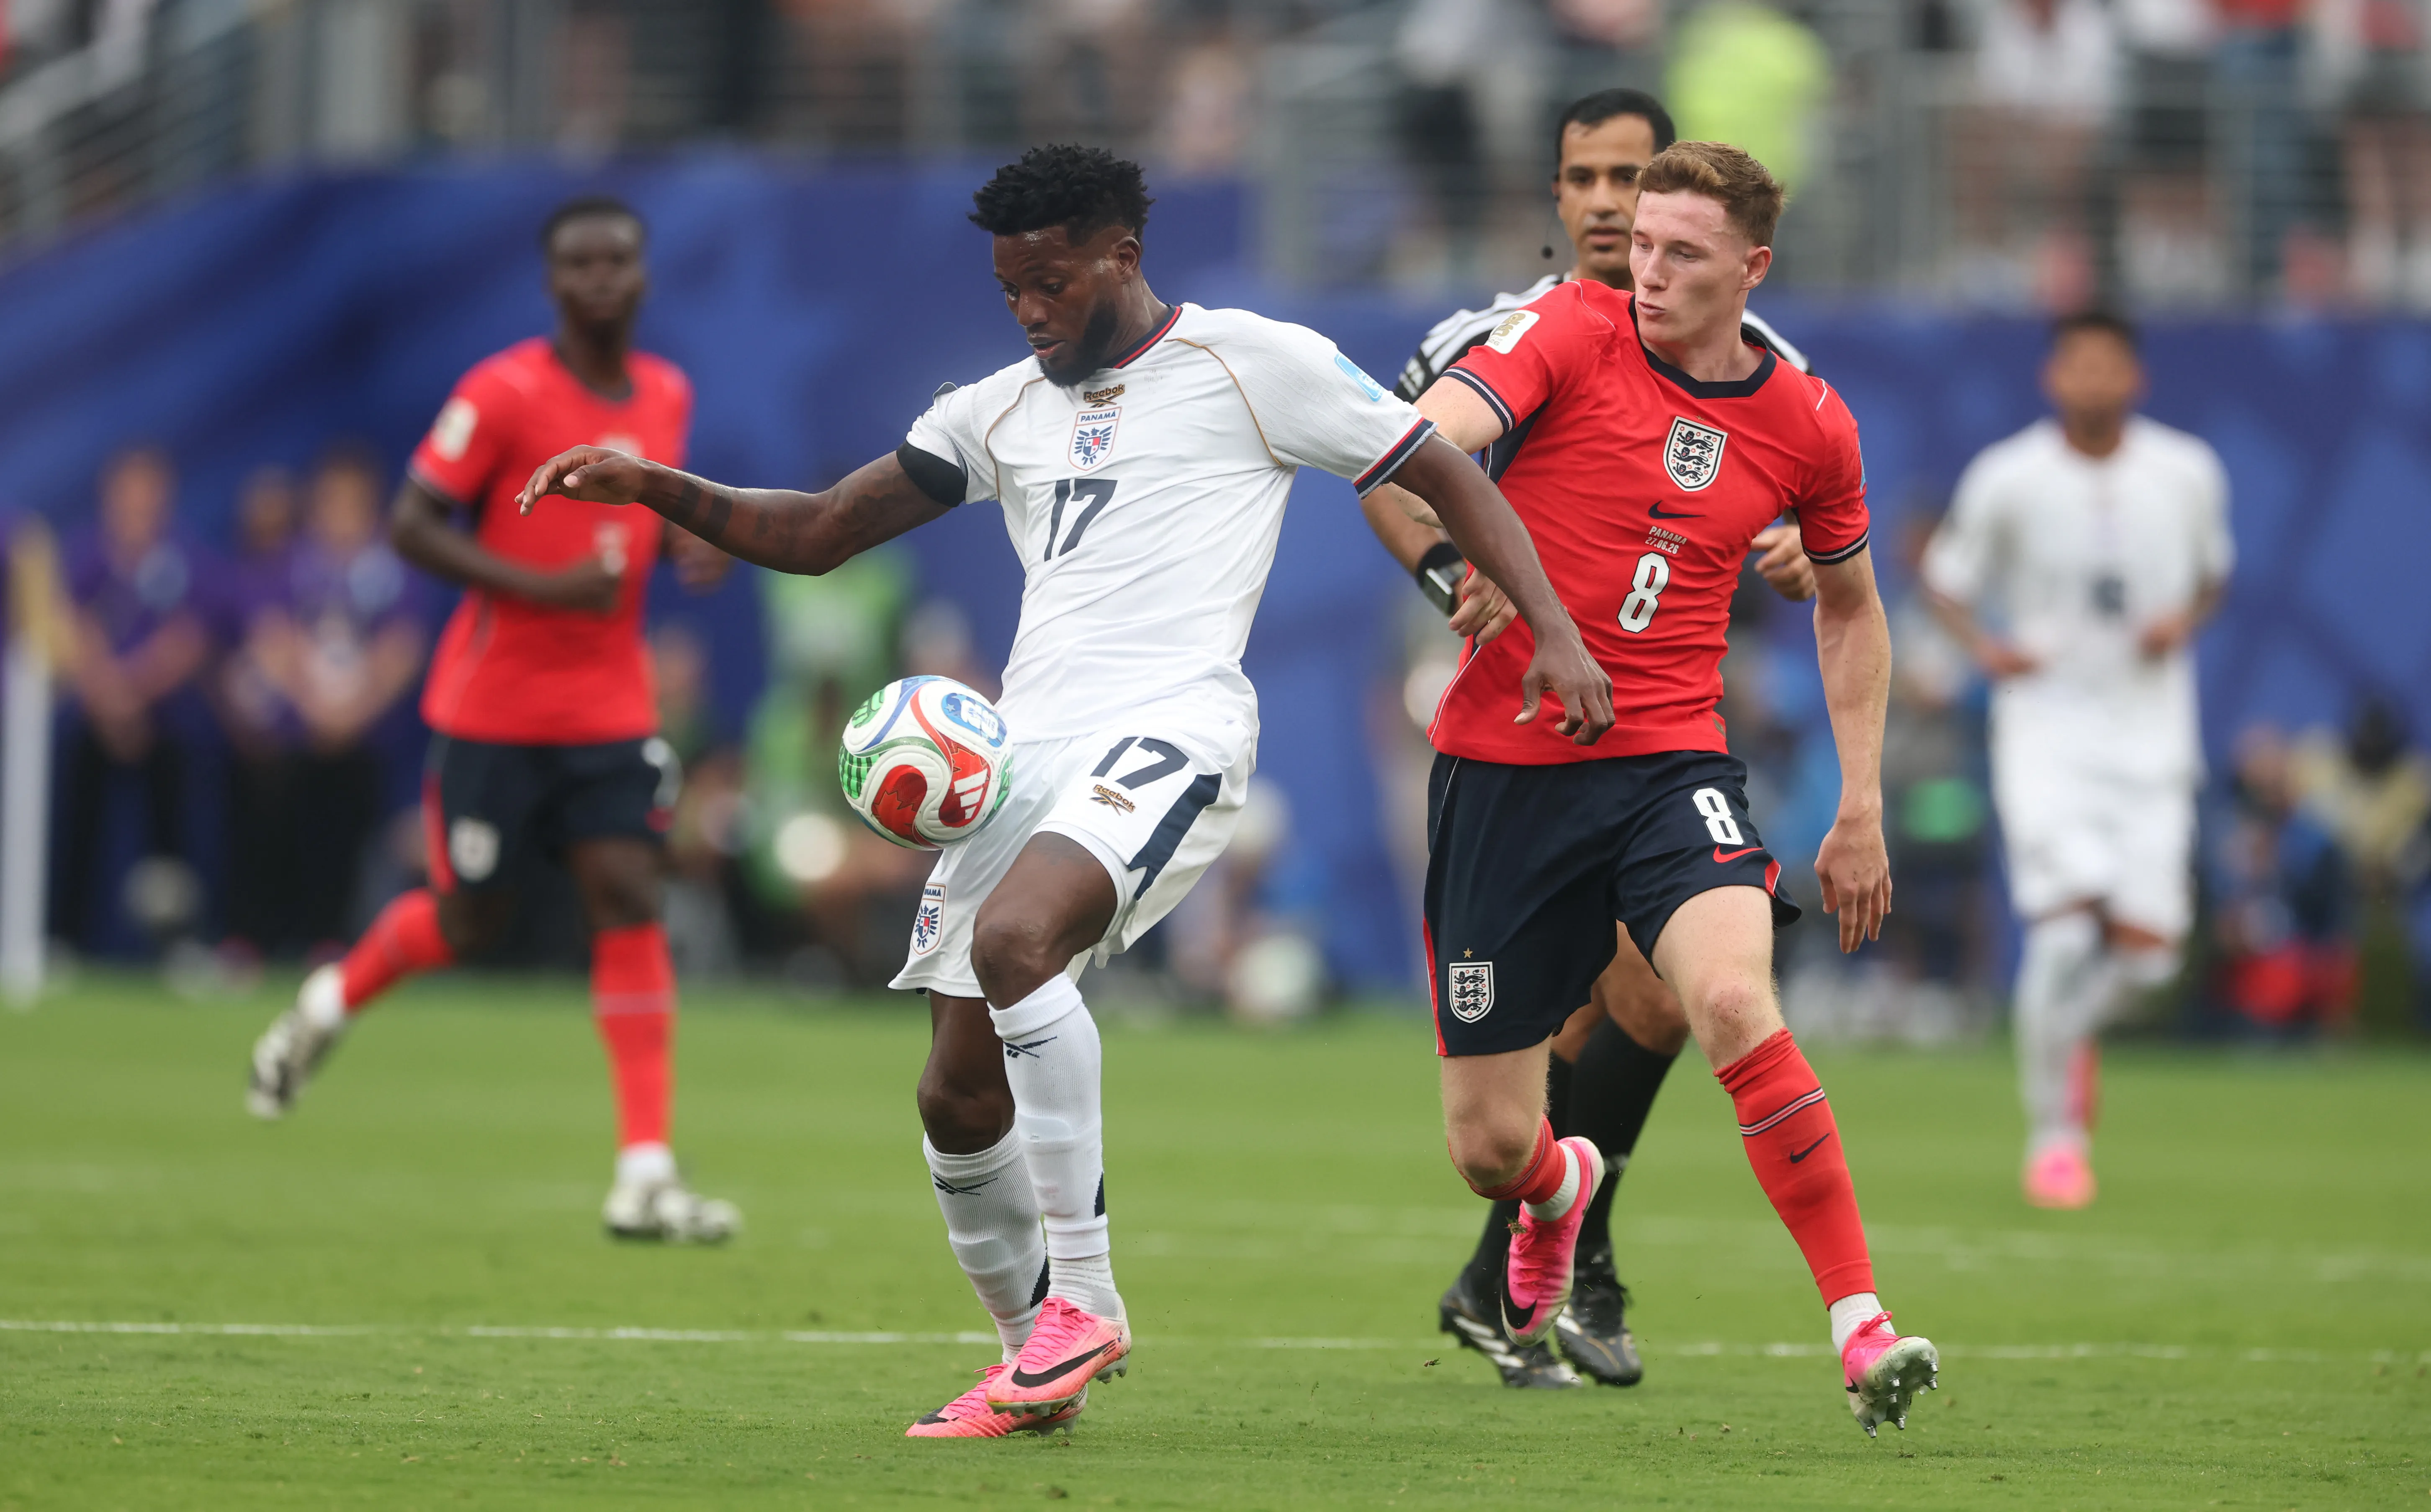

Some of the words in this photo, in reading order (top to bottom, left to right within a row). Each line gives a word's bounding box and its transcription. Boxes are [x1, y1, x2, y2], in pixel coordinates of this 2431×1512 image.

[1083, 383, 1125, 401] Reebok
[1080, 410, 1116, 422] PANAMÁ
[1044, 478, 1118, 562] 17
[1645, 537, 1679, 554] 27.06.26
[1649, 526, 1688, 545] PANAMA
[1617, 551, 1670, 634] 8
[1089, 737, 1190, 790] 17
[1093, 784, 1135, 812] Reebok
[1690, 786, 1746, 845] 8
[924, 888, 941, 897] NAMÁ
